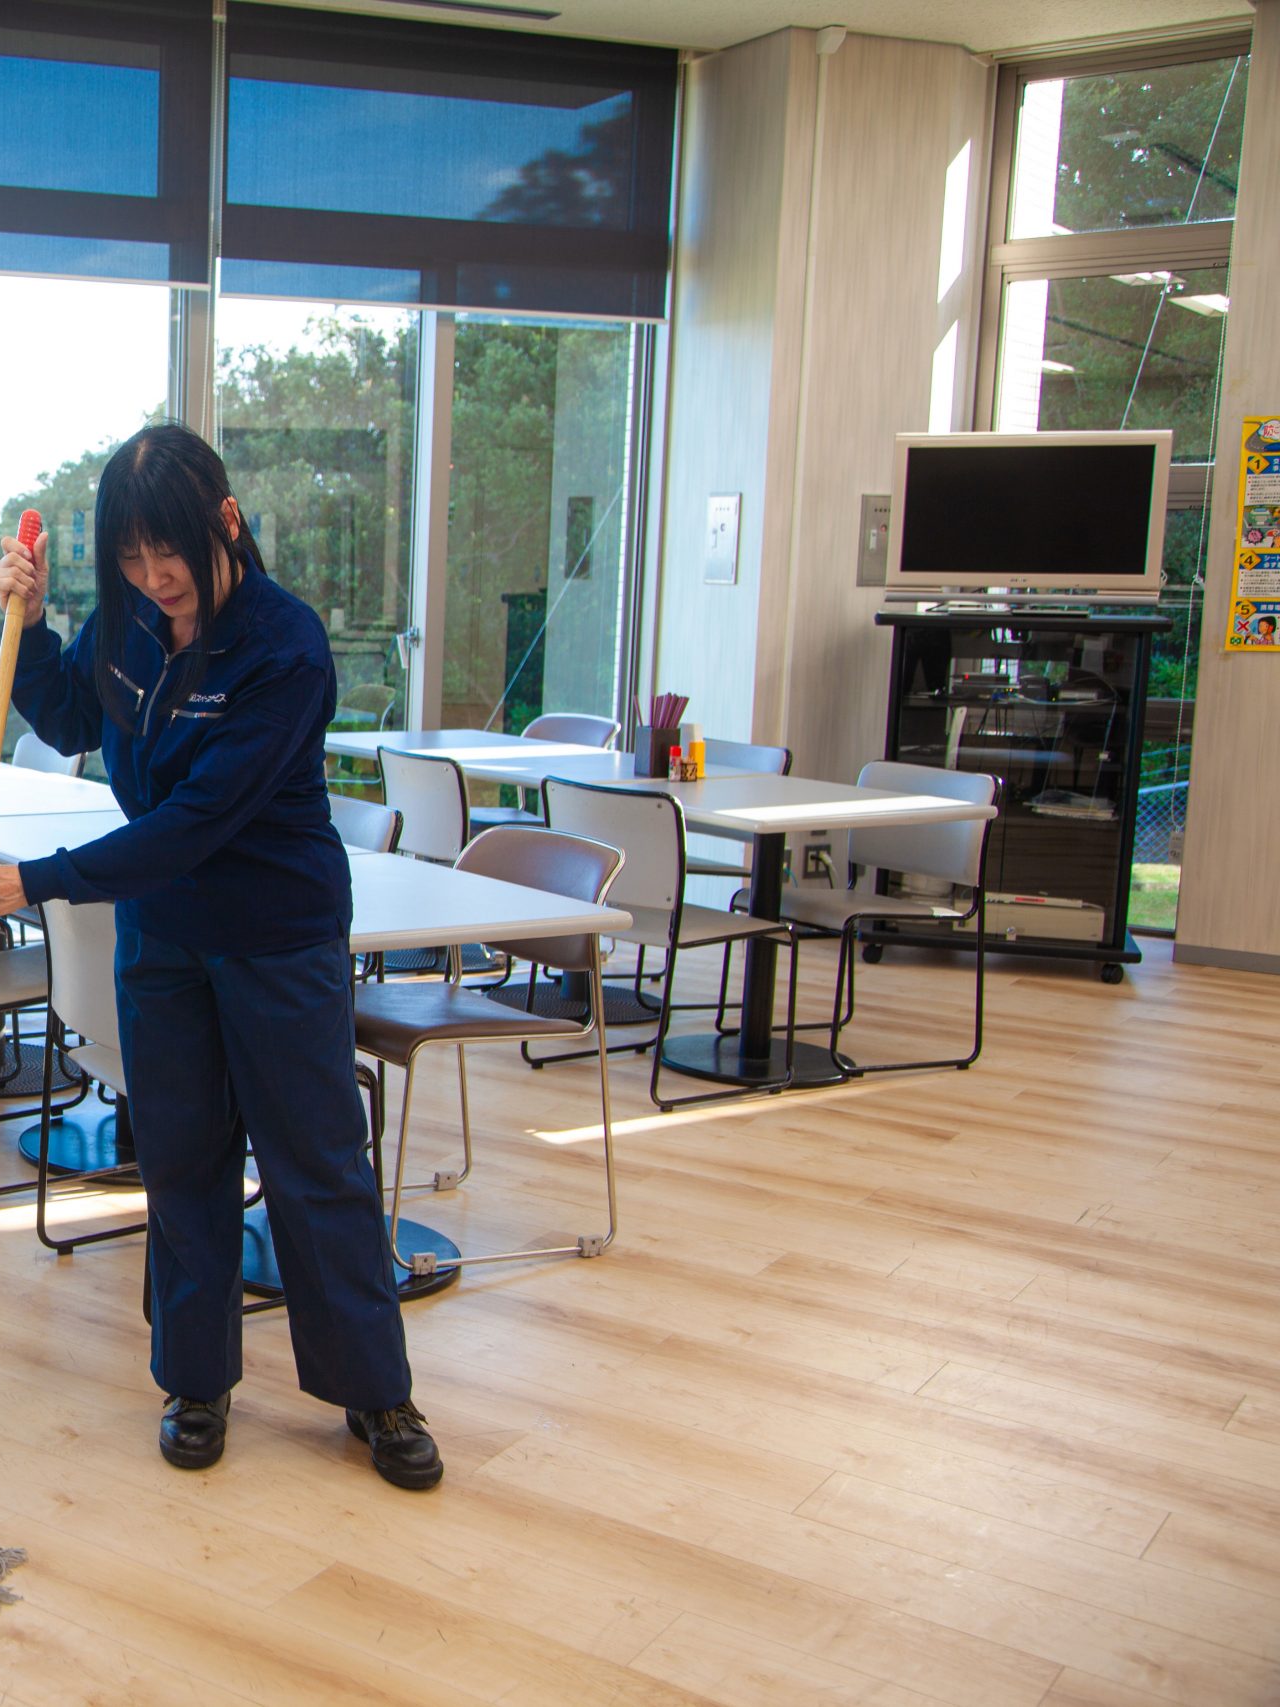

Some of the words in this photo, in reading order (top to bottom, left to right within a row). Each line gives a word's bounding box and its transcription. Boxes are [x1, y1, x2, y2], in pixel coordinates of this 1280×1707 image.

[1254, 459, 1261, 470] 1
[1244, 555, 1253, 565] 4
[1241, 604, 1250, 615] 5
